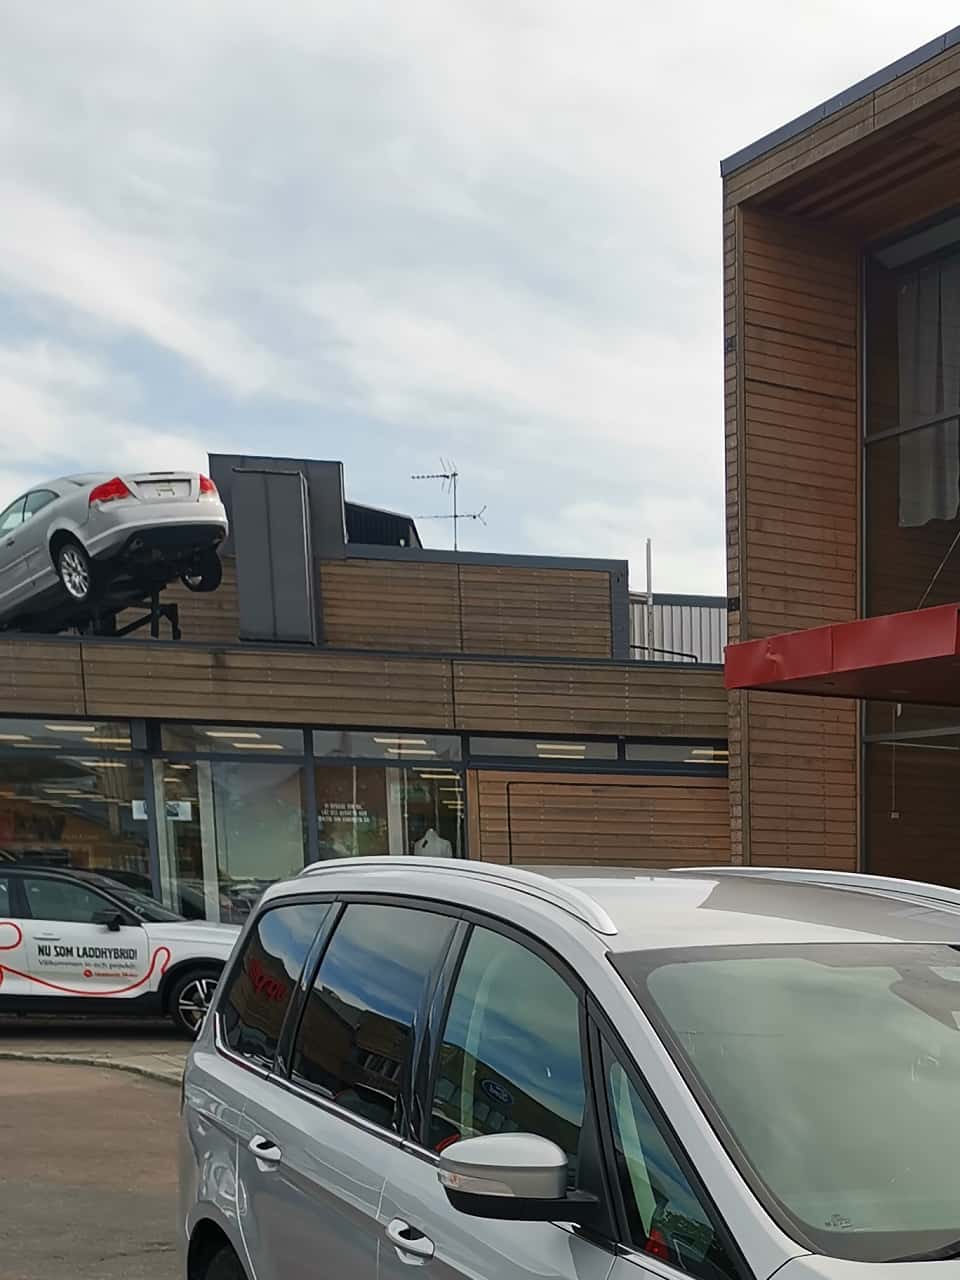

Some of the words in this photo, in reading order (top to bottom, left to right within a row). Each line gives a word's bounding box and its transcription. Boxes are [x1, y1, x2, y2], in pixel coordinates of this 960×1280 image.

[37, 944, 51, 957] NU
[54, 945, 74, 958] SOM
[76, 946, 138, 961] LADDHYBRID!
